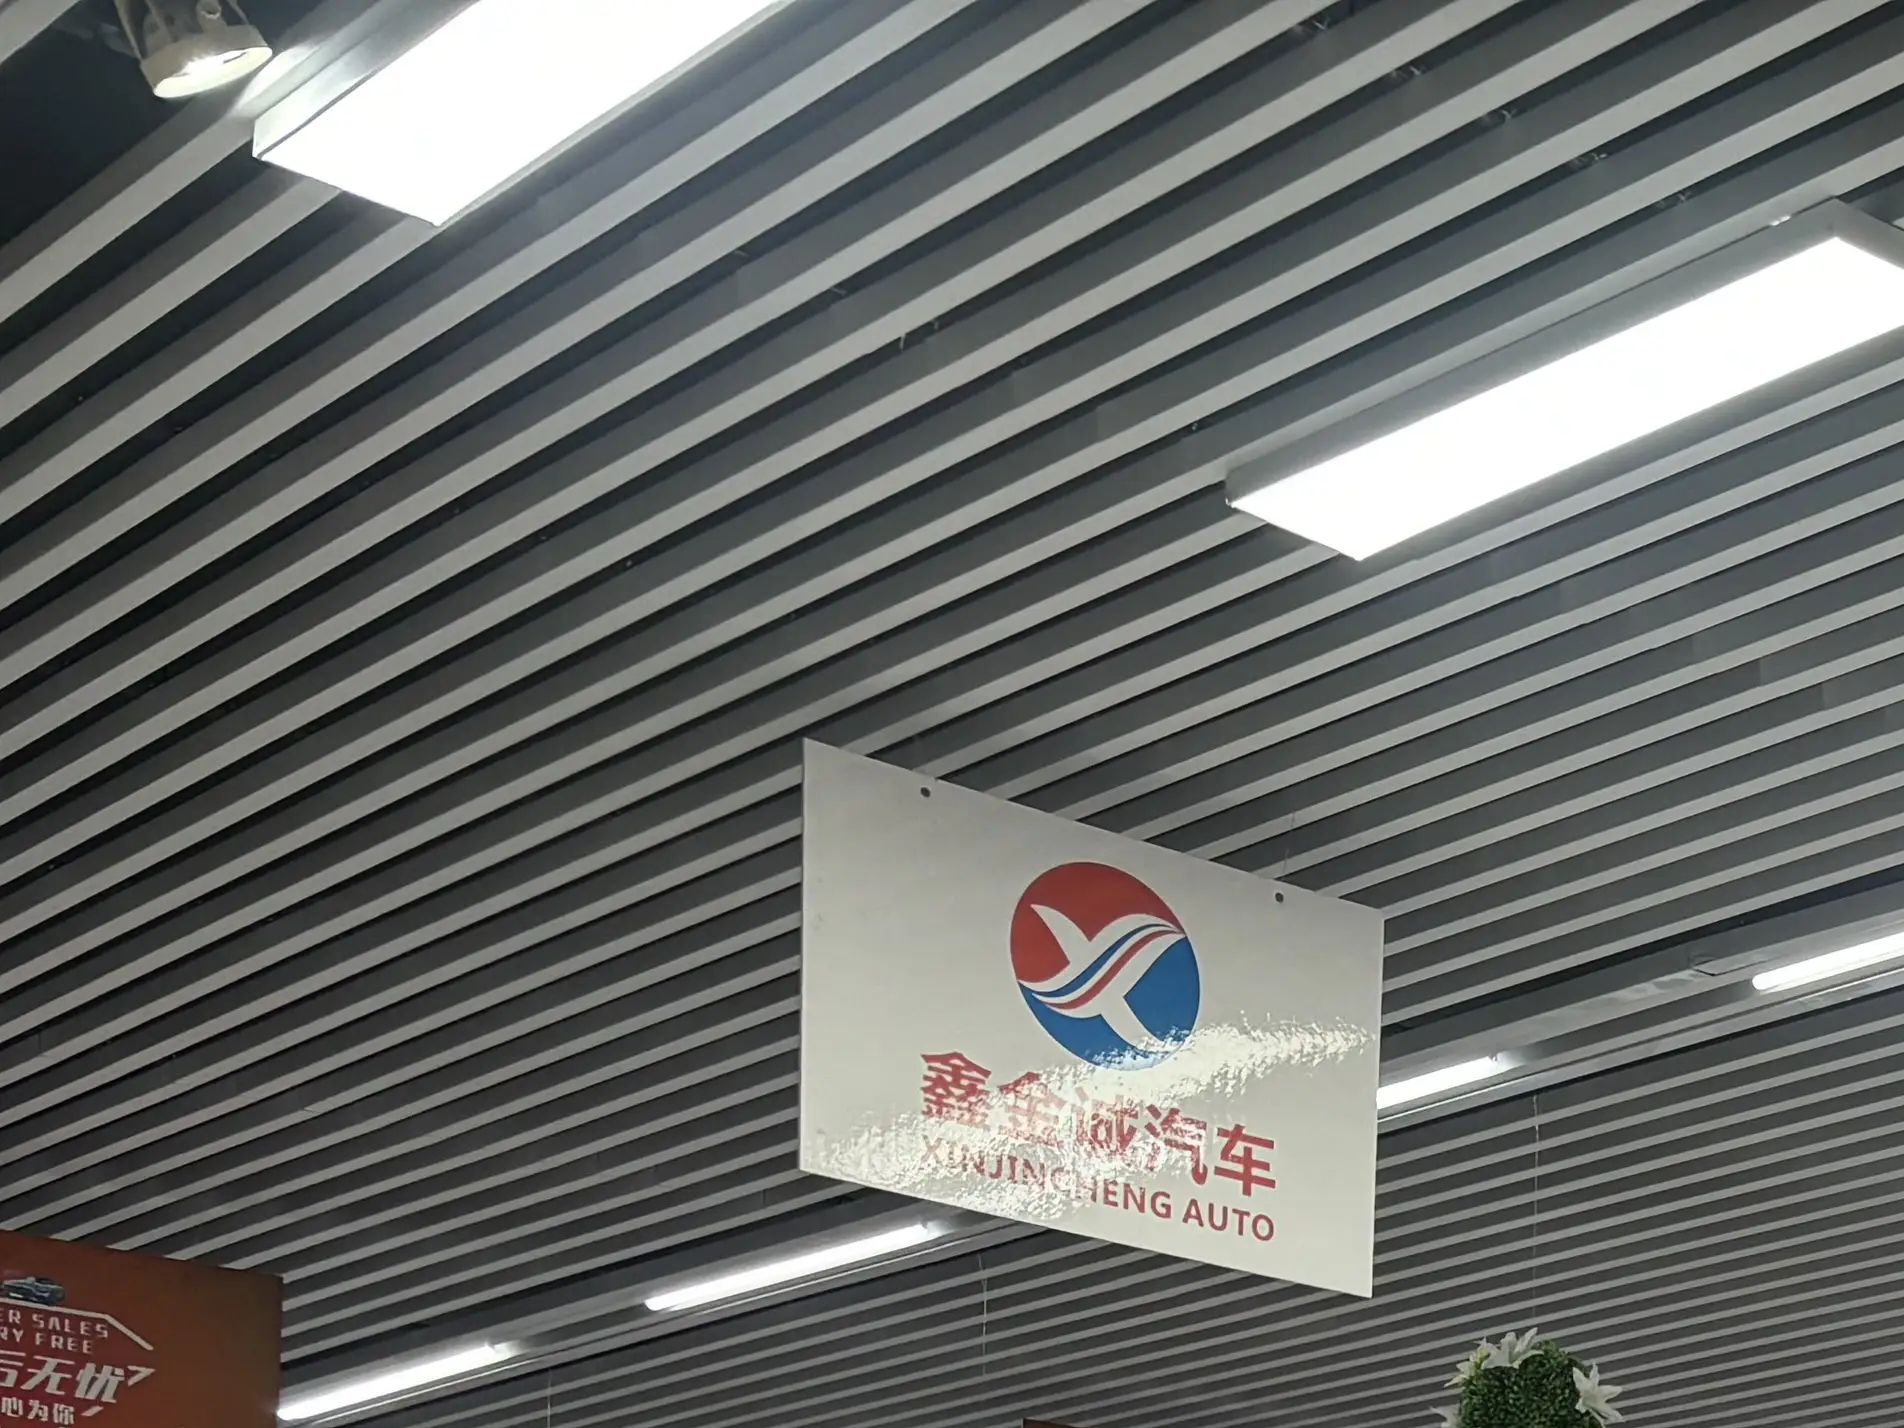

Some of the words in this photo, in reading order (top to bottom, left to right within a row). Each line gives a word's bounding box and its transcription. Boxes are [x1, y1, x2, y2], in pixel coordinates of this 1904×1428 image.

[920, 1051, 1277, 1198] 鑫金诚汽车
[1182, 1197, 1276, 1242] AUTO
[32, 1313, 109, 1338] SALES
[35, 1333, 94, 1354] FREE
